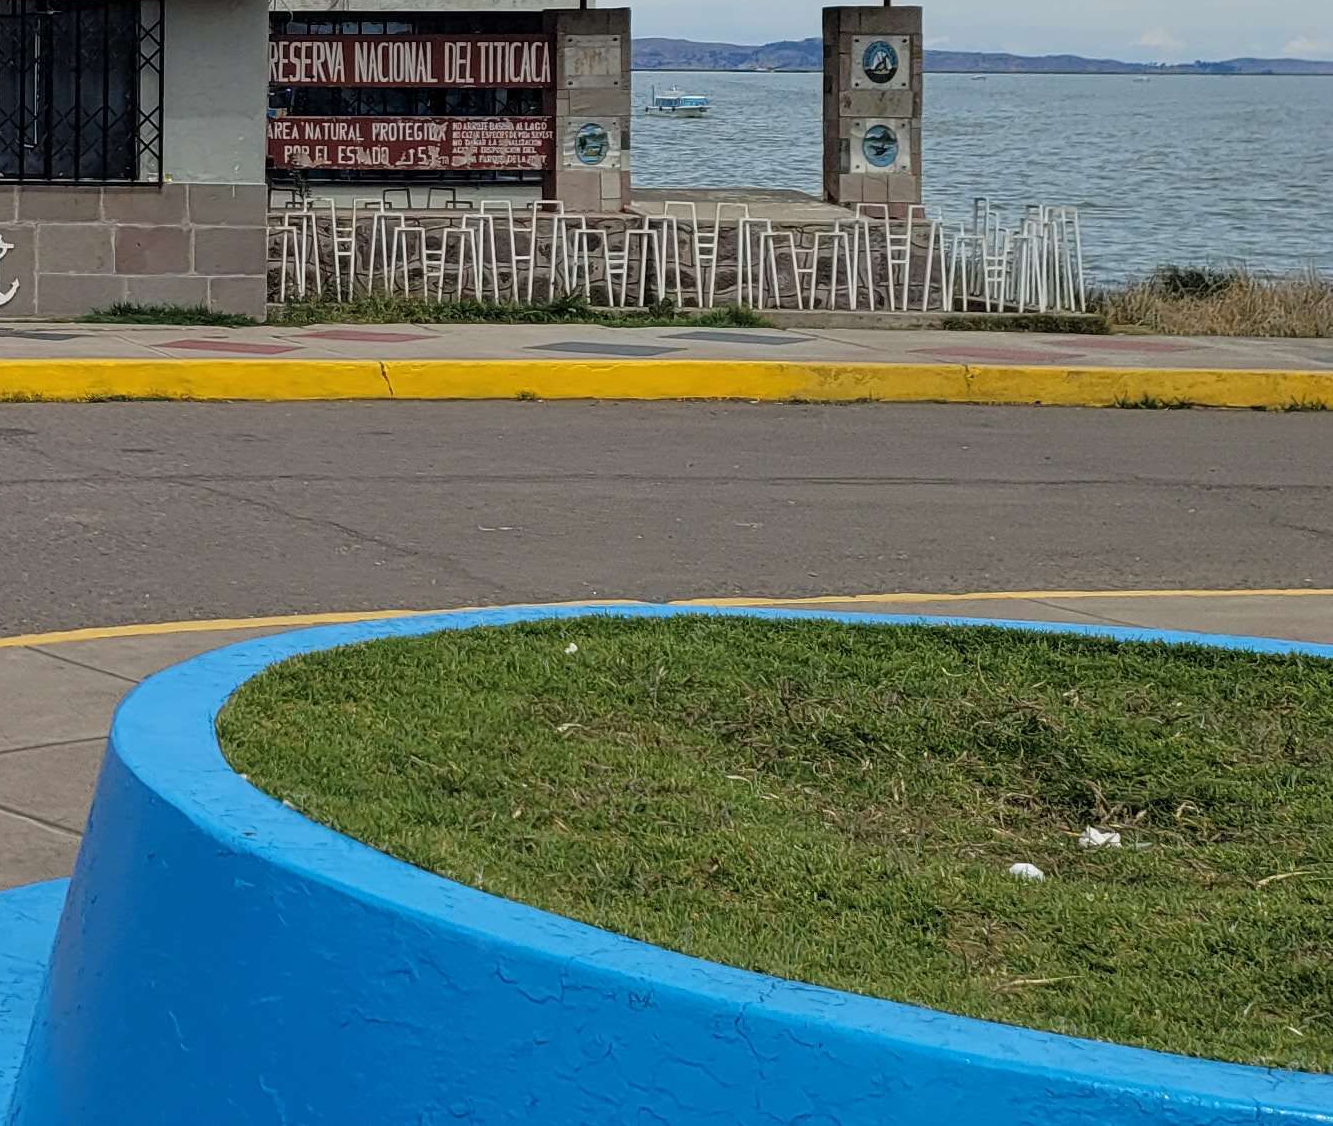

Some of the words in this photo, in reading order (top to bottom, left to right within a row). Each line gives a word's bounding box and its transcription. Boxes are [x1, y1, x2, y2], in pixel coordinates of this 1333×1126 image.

[269, 41, 345, 83] RESERVA
[355, 41, 438, 83] NACIONAL
[445, 42, 474, 83] DEL
[477, 42, 551, 83] TITICACA
[267, 123, 299, 140] AREA
[305, 123, 364, 141] NATURAL
[525, 122, 547, 130] LAGO
[315, 146, 332, 164] EL
